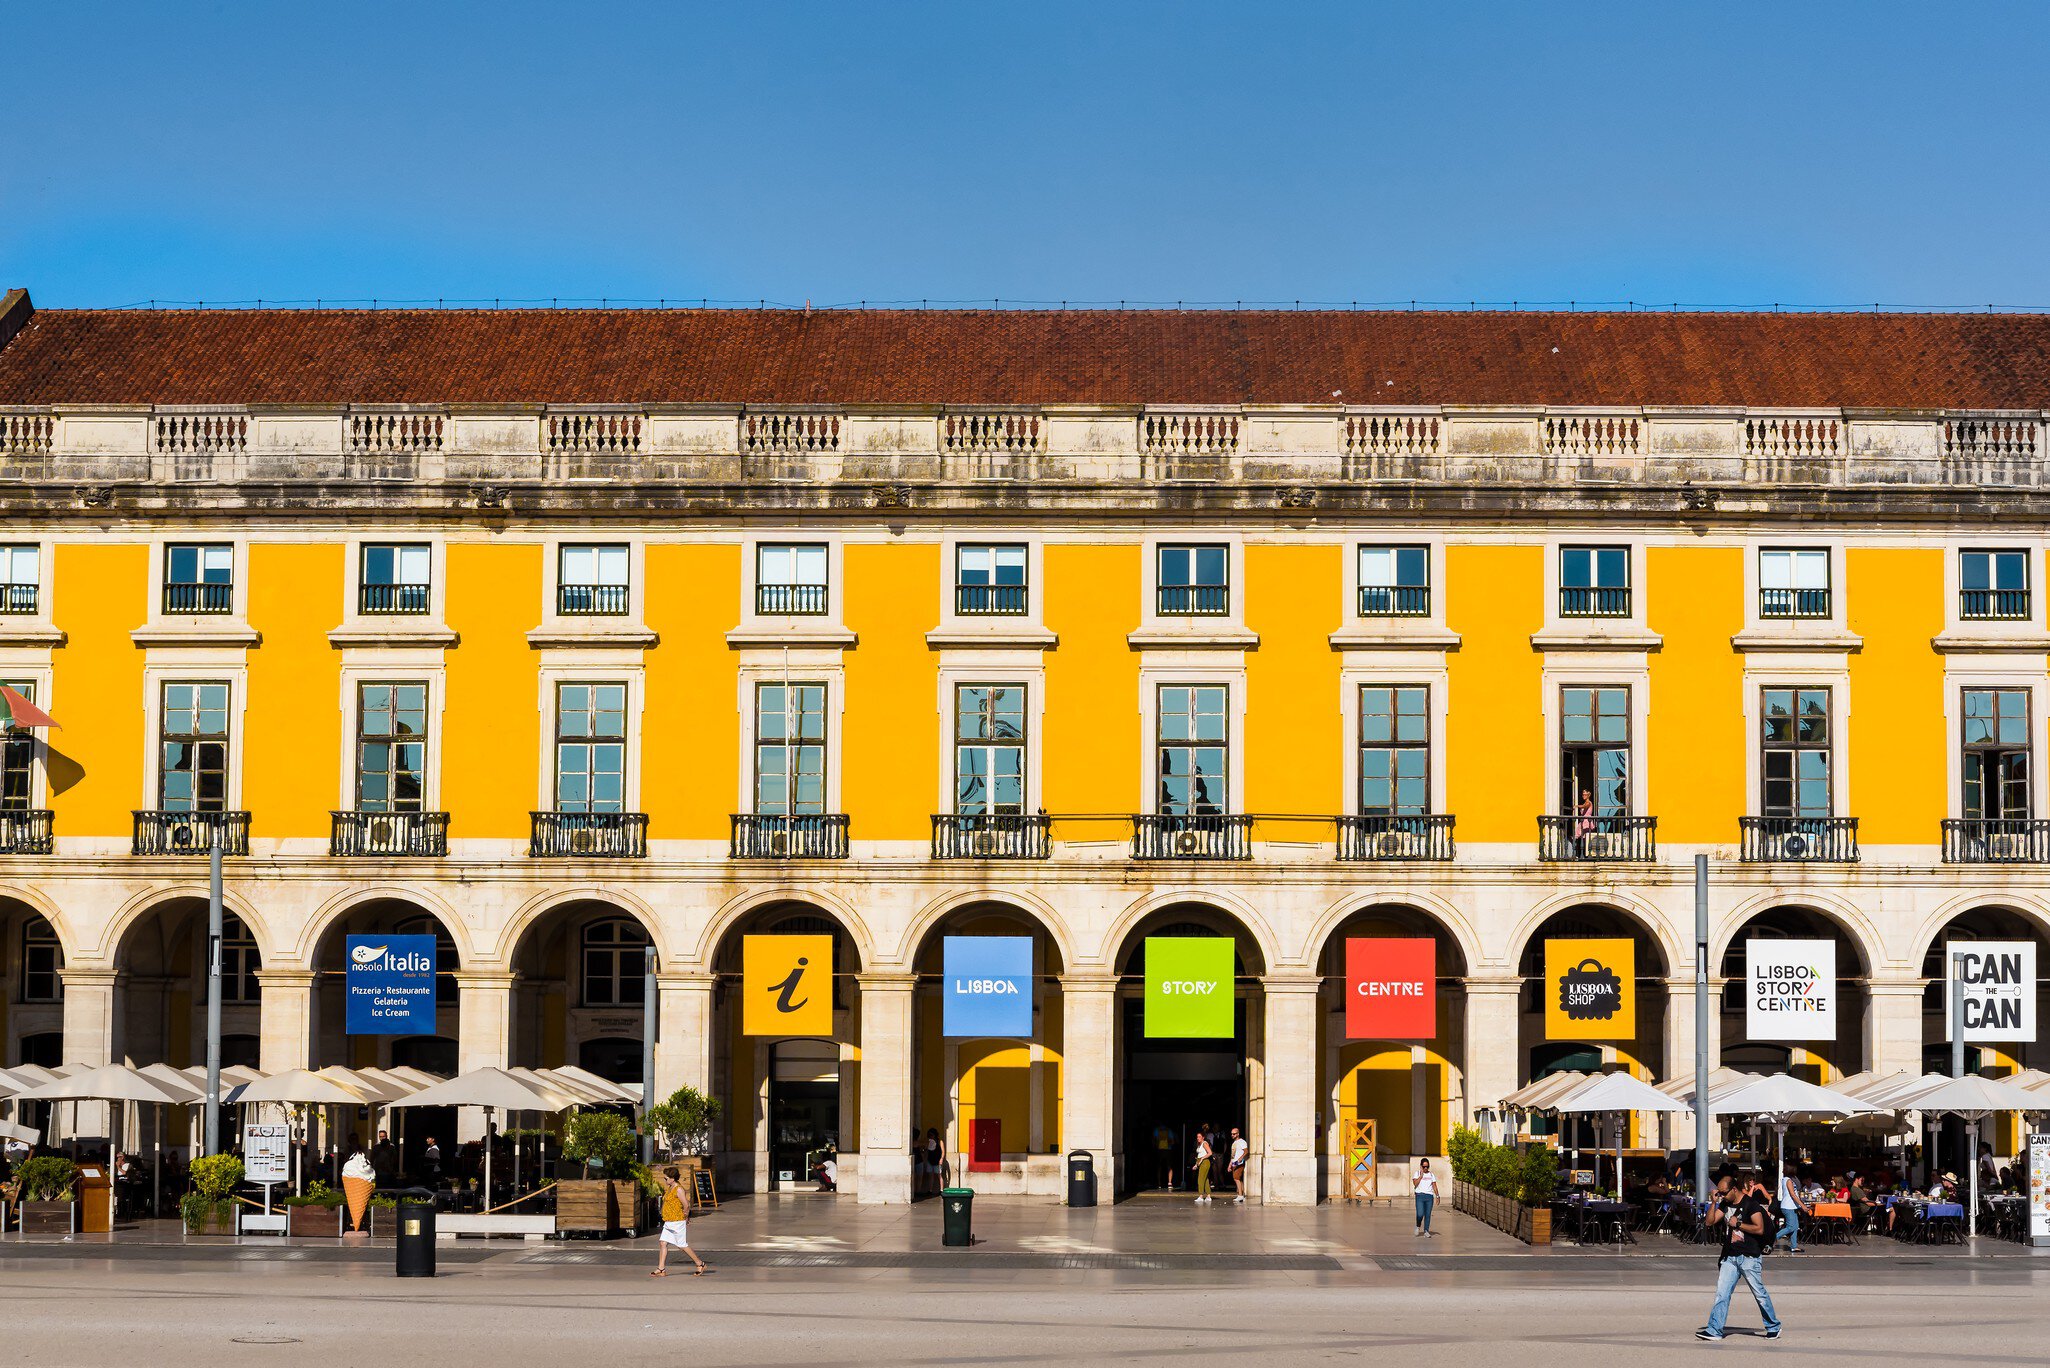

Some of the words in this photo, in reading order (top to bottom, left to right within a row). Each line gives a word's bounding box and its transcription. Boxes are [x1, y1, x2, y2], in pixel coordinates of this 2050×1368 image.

[352, 962, 383, 972] nosolo
[384, 951, 431, 972] Italia
[1963, 953, 2022, 984] CAN
[1756, 965, 1821, 979] LISBOA
[352, 986, 382, 995] Pizzeria
[386, 986, 430, 995] Restaurante
[956, 979, 1019, 994] LISBOA
[1162, 981, 1217, 995] STORY
[1357, 981, 1424, 996] CENTRE
[1568, 983, 1614, 995] LISBOA
[1756, 981, 1814, 995] STORY
[1985, 987, 1998, 995] THE
[373, 997, 408, 1006] Gelateria
[1568, 994, 1596, 1005] SHOP
[1756, 997, 1826, 1012] CENTRE
[371, 1008, 383, 1017] Ice
[385, 1008, 410, 1017] Cream
[1963, 998, 2022, 1029] CAN
